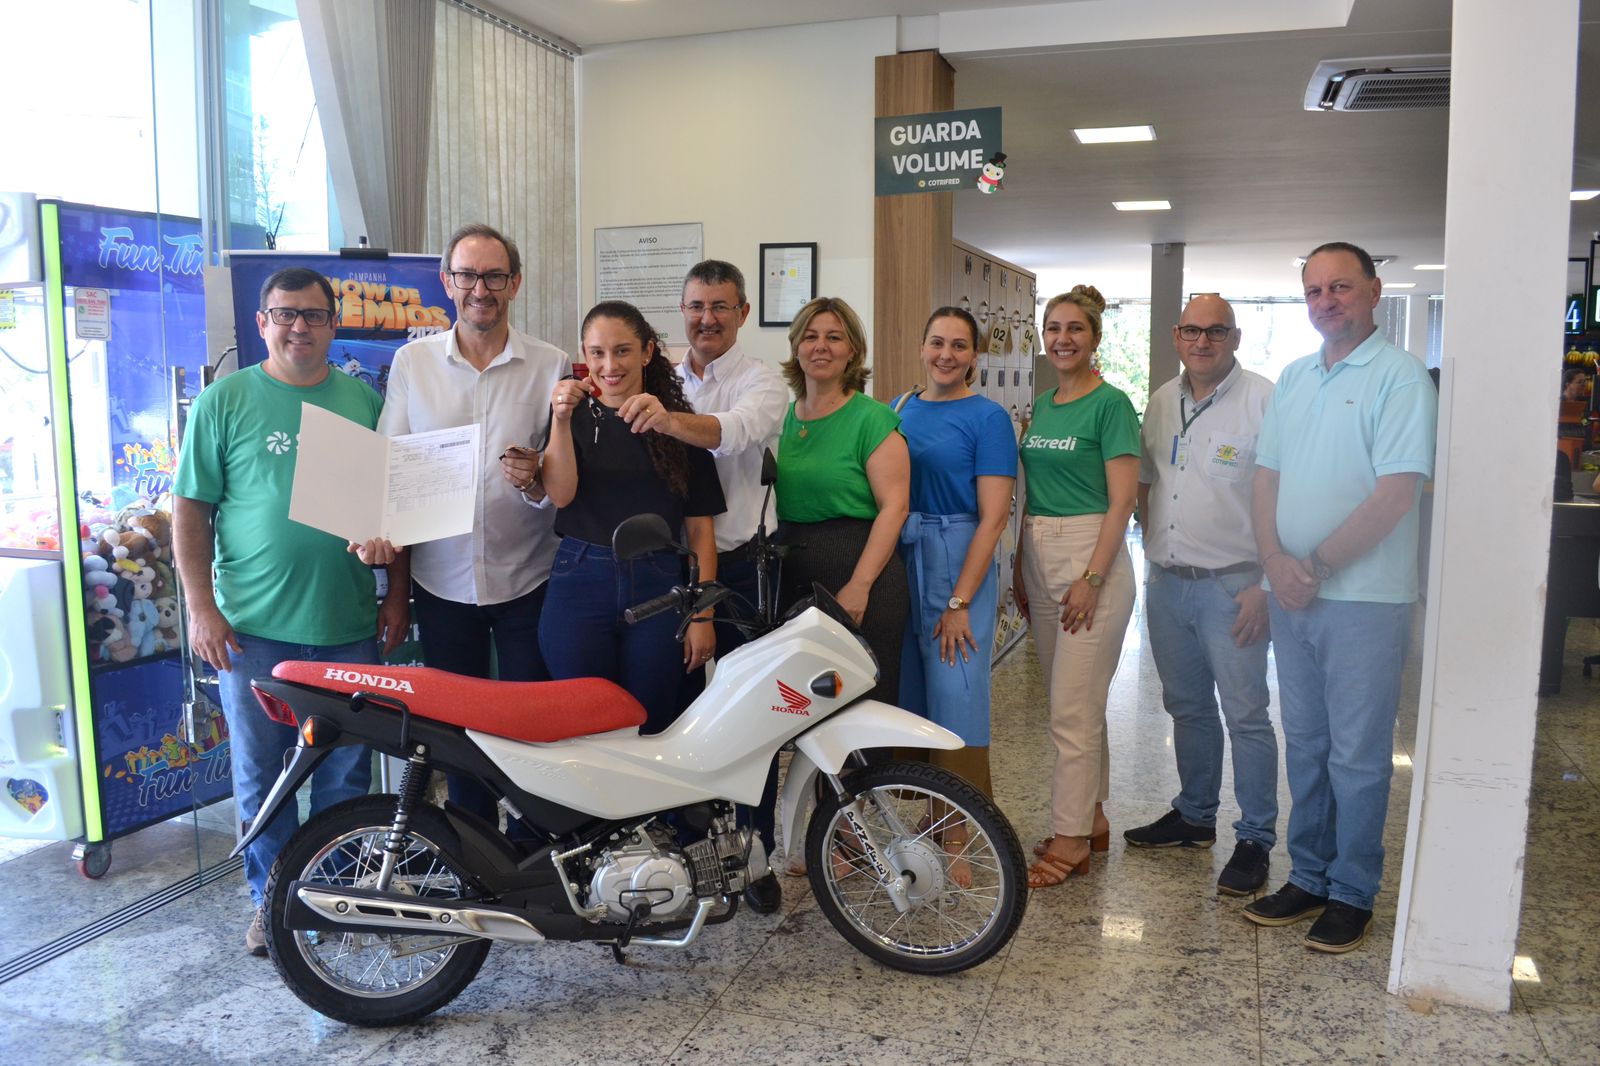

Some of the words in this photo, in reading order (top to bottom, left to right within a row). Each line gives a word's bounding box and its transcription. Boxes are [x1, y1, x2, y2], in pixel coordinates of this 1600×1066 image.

[889, 119, 982, 146] GUARDA
[892, 148, 984, 175] VOLUME
[928, 178, 960, 187] COTRIFRED
[99, 226, 163, 273] Fun
[349, 272, 387, 282] CAMPANHA
[325, 277, 387, 301] HOW
[390, 285, 422, 305] DE
[993, 327, 1006, 342] 02
[1024, 329, 1034, 343] 04
[1026, 435, 1077, 451] Sicredi
[323, 667, 415, 694] HONDA
[771, 705, 810, 717] HONDA
[139, 760, 197, 807] Fun
